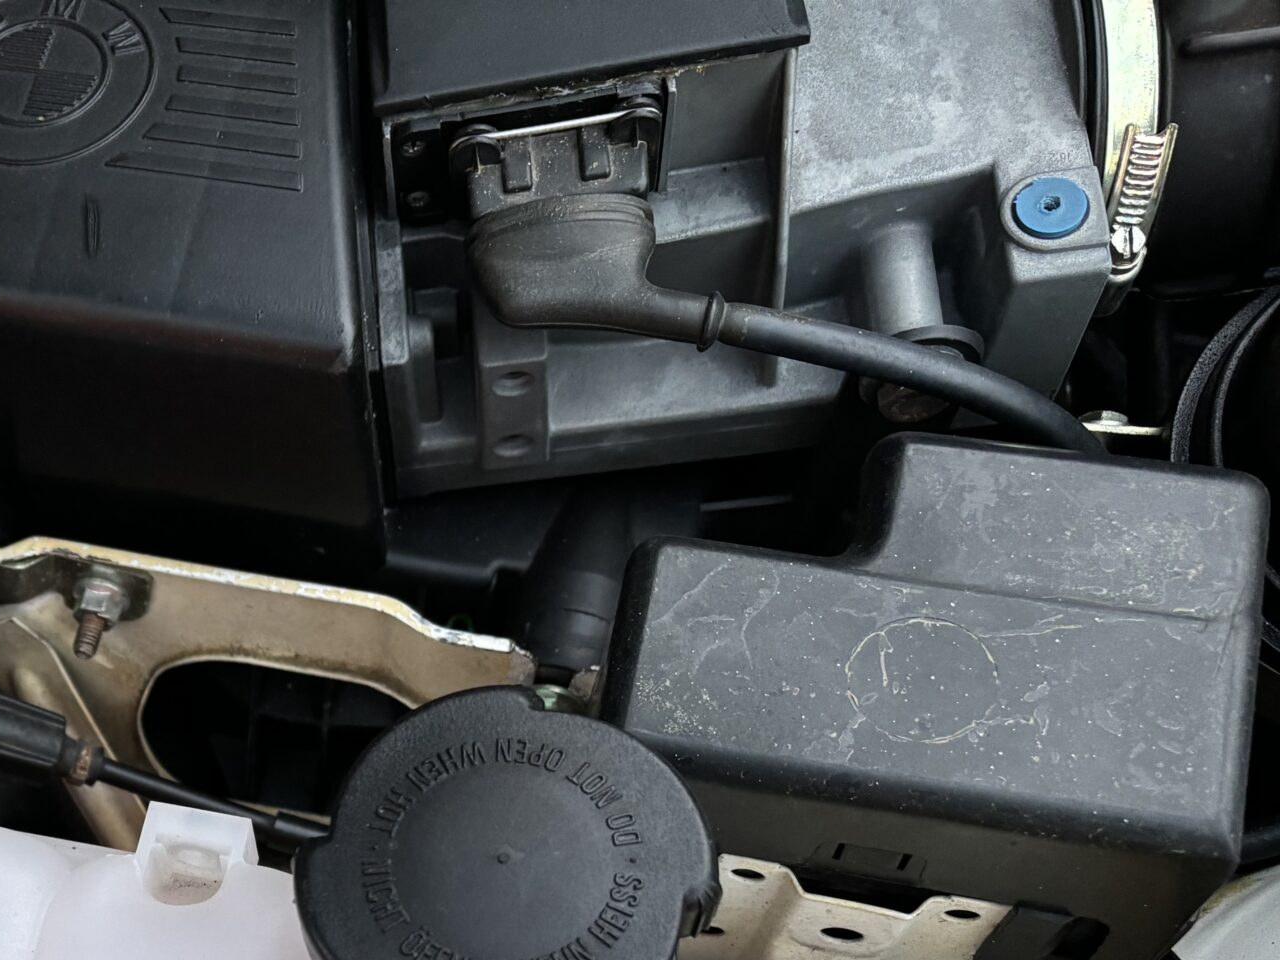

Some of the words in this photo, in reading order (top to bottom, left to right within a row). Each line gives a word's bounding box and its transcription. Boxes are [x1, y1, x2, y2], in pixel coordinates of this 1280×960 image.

[406, 742, 485, 792] WHEN
[495, 738, 566, 773] OPEN
[566, 762, 623, 809] NOT
[366, 786, 413, 838] HOT
[605, 813, 643, 847] DO
[361, 861, 410, 934] NICHT
[587, 872, 644, 949] HEISS
